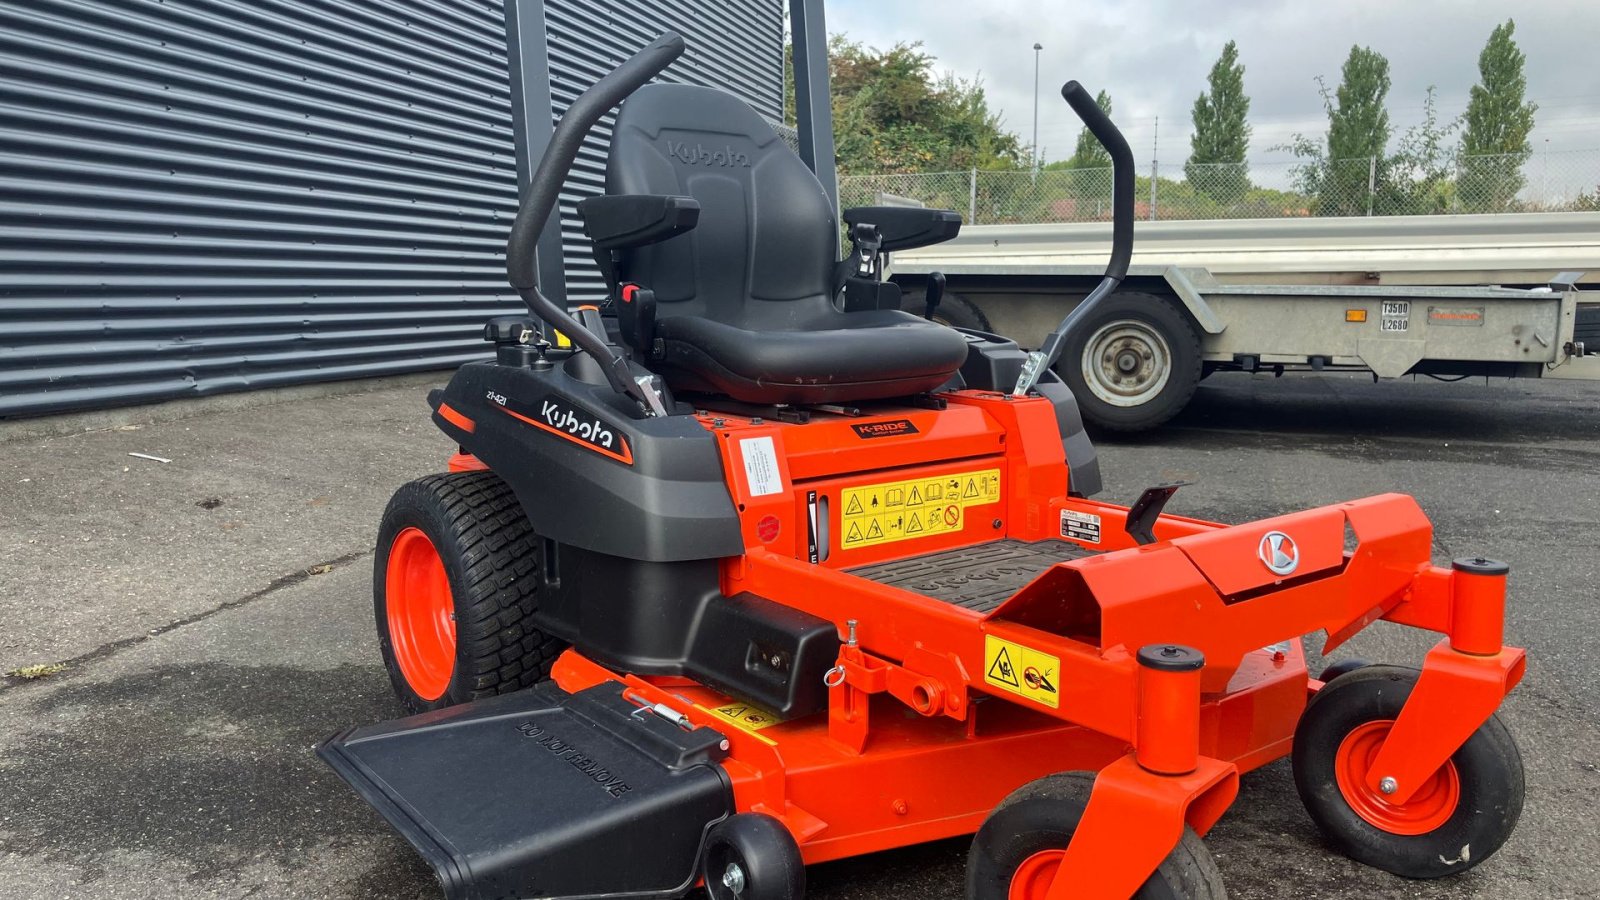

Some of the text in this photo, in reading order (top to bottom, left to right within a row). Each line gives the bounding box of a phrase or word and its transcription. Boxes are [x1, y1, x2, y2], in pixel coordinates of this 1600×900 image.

[667, 140, 752, 168] Kubota
[1383, 303, 1408, 313] T3500
[1382, 319, 1408, 330] L2680
[541, 400, 614, 448] Kubota
[809, 492, 815, 502] F
[811, 554, 817, 564] E
[515, 720, 633, 798] DO NOT REMOVE
